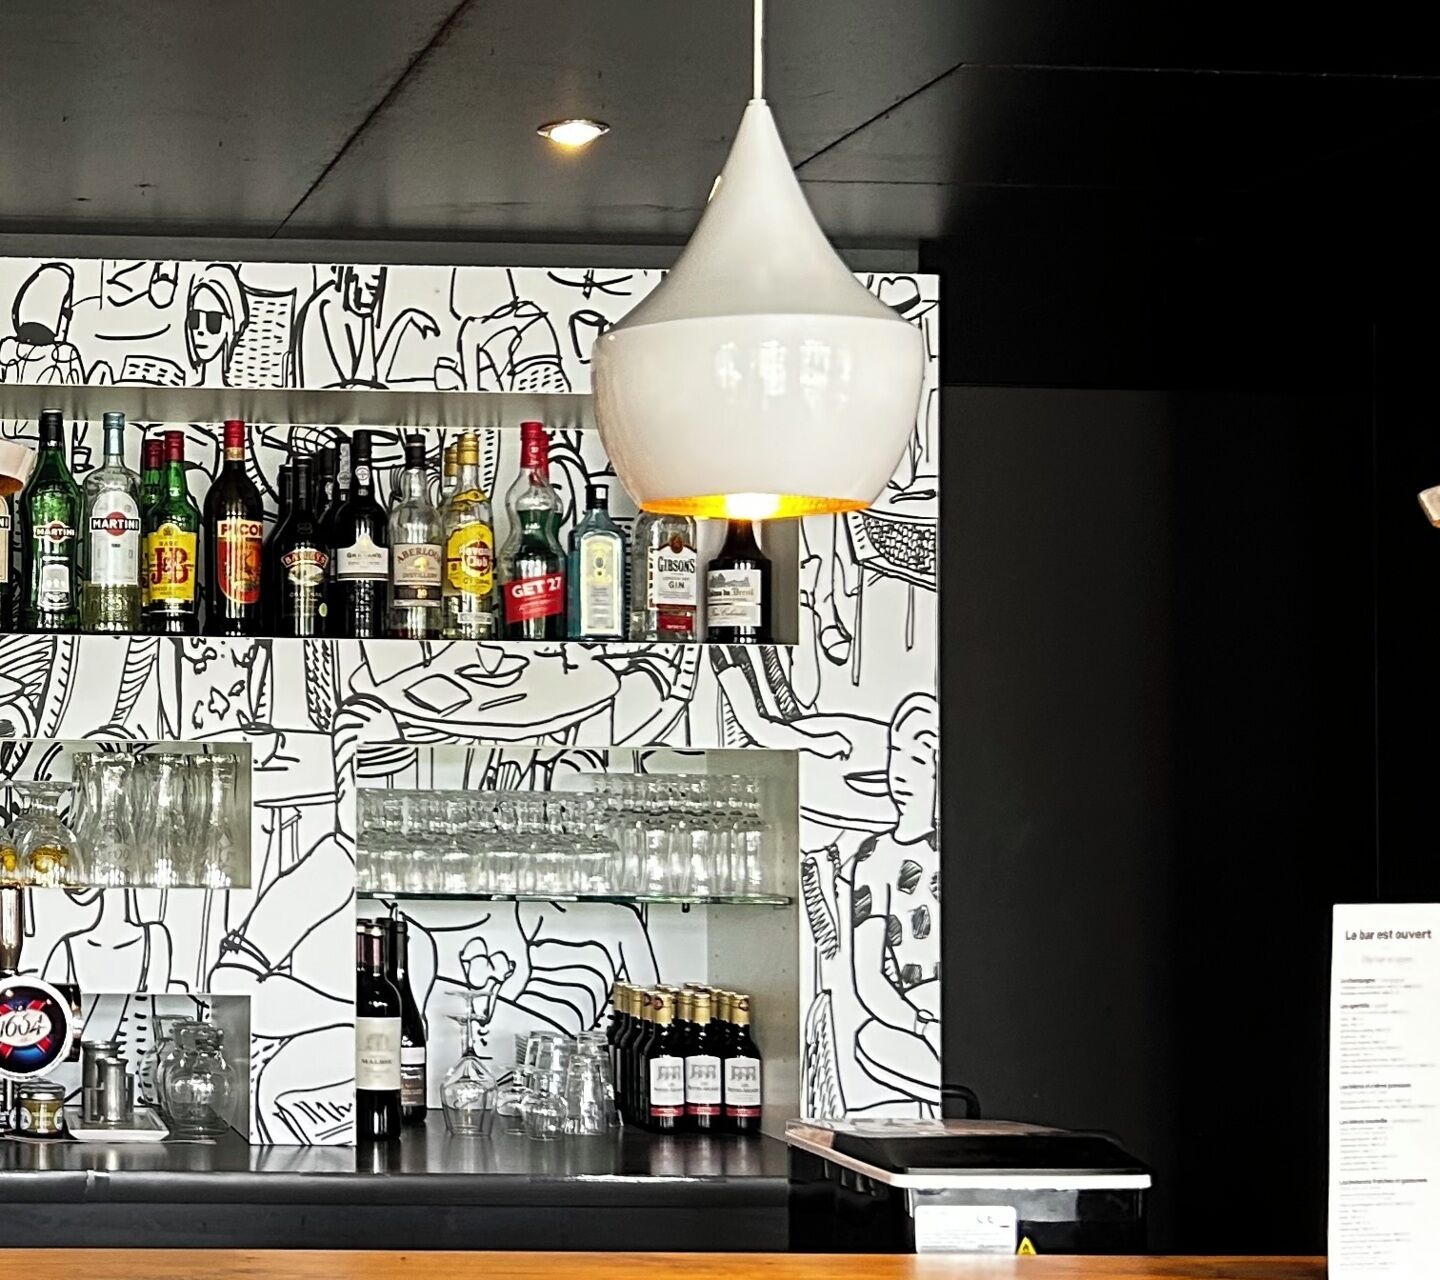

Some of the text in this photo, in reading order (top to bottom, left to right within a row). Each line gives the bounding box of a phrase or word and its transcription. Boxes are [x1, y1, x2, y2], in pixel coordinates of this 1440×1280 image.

[93, 519, 139, 530] MARTINI
[220, 524, 263, 536] PCON
[36, 528, 74, 536] MARTINI
[151, 548, 190, 584] J&B
[512, 576, 562, 598] GET 27
[668, 581, 685, 589] GIN
[1345, 929, 1432, 940] Le bar est ouvert
[0, 1014, 45, 1038] 1664
